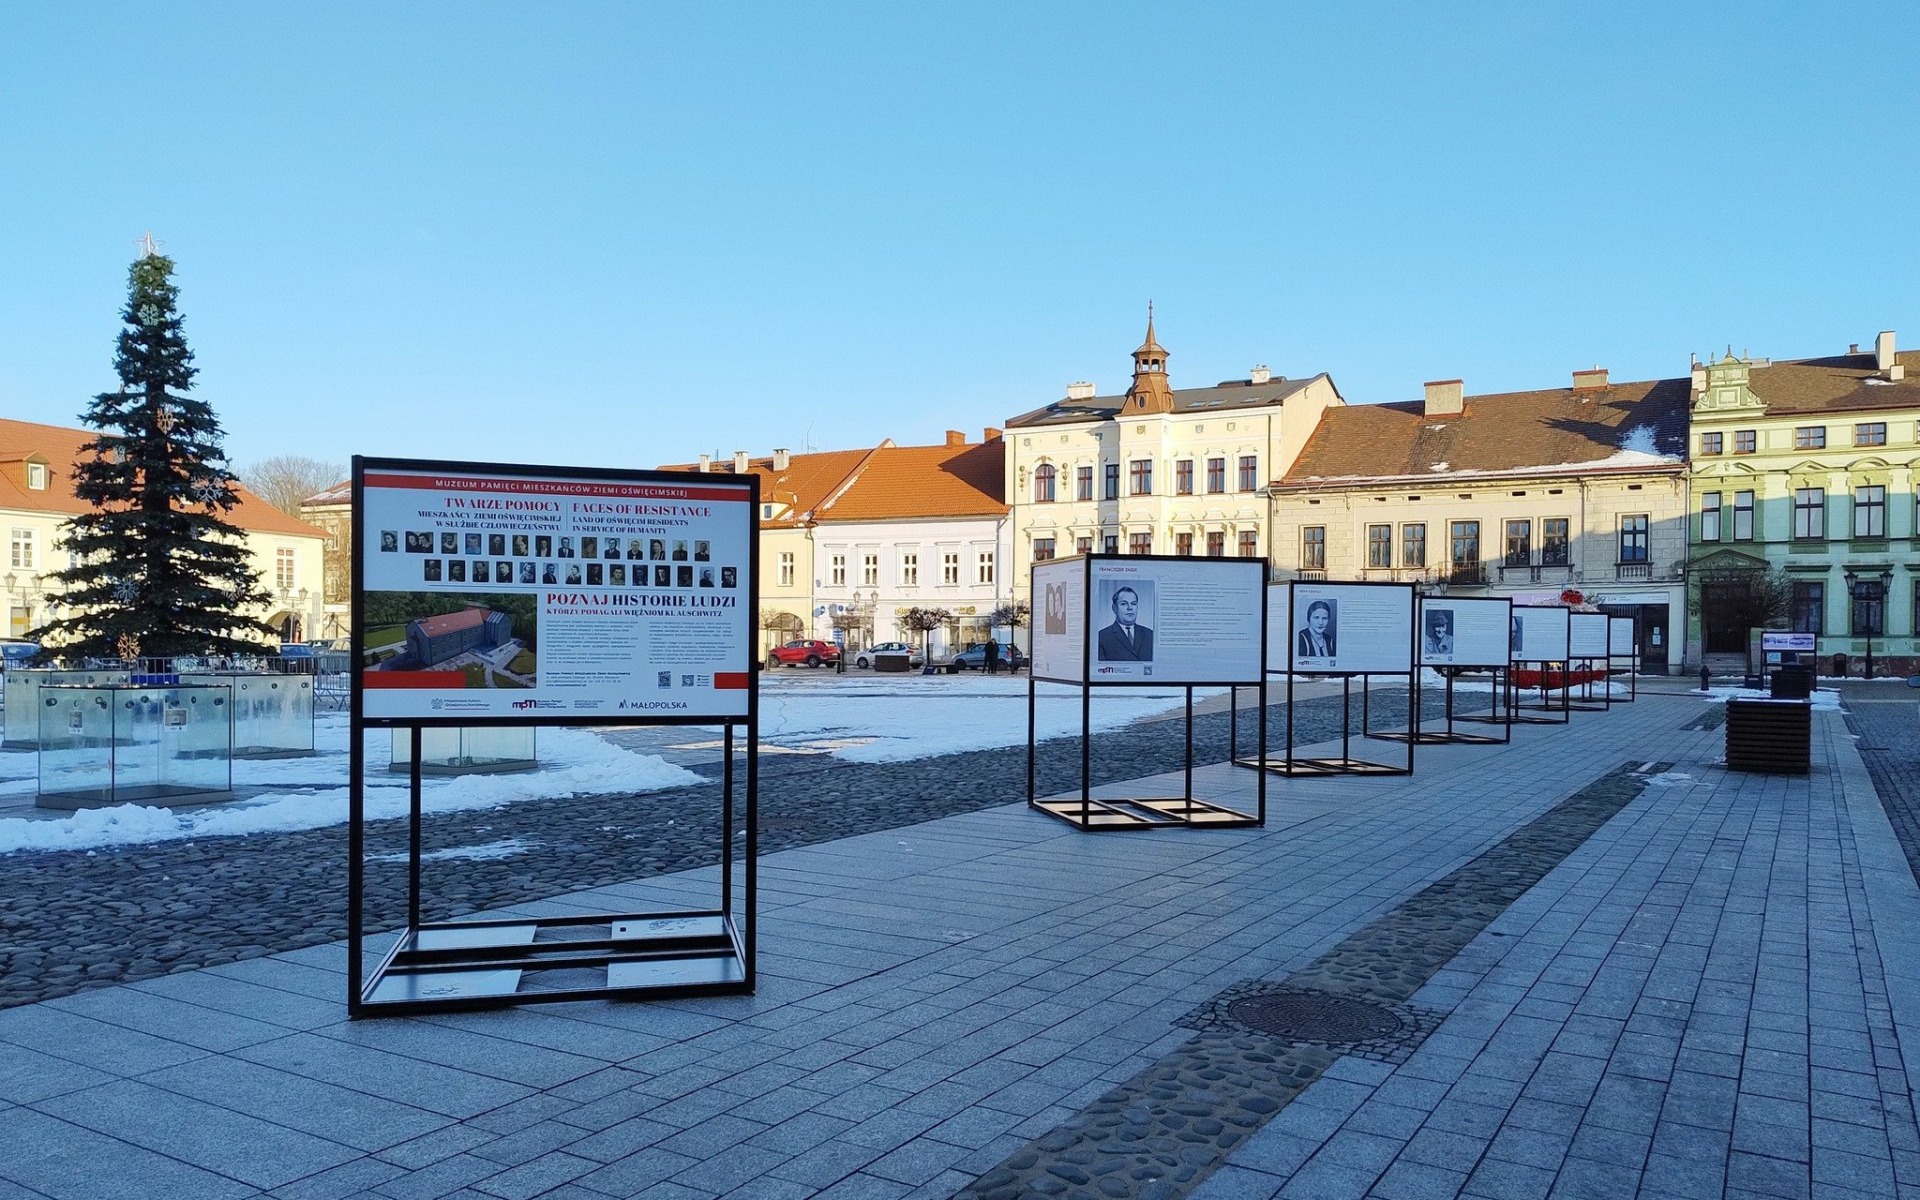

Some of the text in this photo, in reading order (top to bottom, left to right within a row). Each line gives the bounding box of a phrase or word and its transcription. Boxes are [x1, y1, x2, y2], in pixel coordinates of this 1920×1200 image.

[435, 480, 688, 497] MUZEUM PAMIĘCI MIESZKAŃCÓW ZIEMI OŚWIĘCIMSKIEJ
[444, 498, 561, 511] TWARZE POMOCY
[573, 503, 711, 517] FACES OF RESISTANCE
[498, 513, 561, 522] OŚWIĘCIMSKIEJ
[606, 516, 646, 526] OŚWIĘCIM
[647, 518, 689, 526] RESIDENTS
[445, 520, 479, 528] SŁUŻBIE
[480, 522, 560, 531] CZŁOWIECZEŃSTWU
[547, 593, 736, 608] POZNAJ HISTORIE LUDZI
[581, 608, 623, 616] POMAGALI
[624, 608, 664, 617] WIĘŹNIOM
[630, 701, 688, 709] MAŁOPOLSKA
